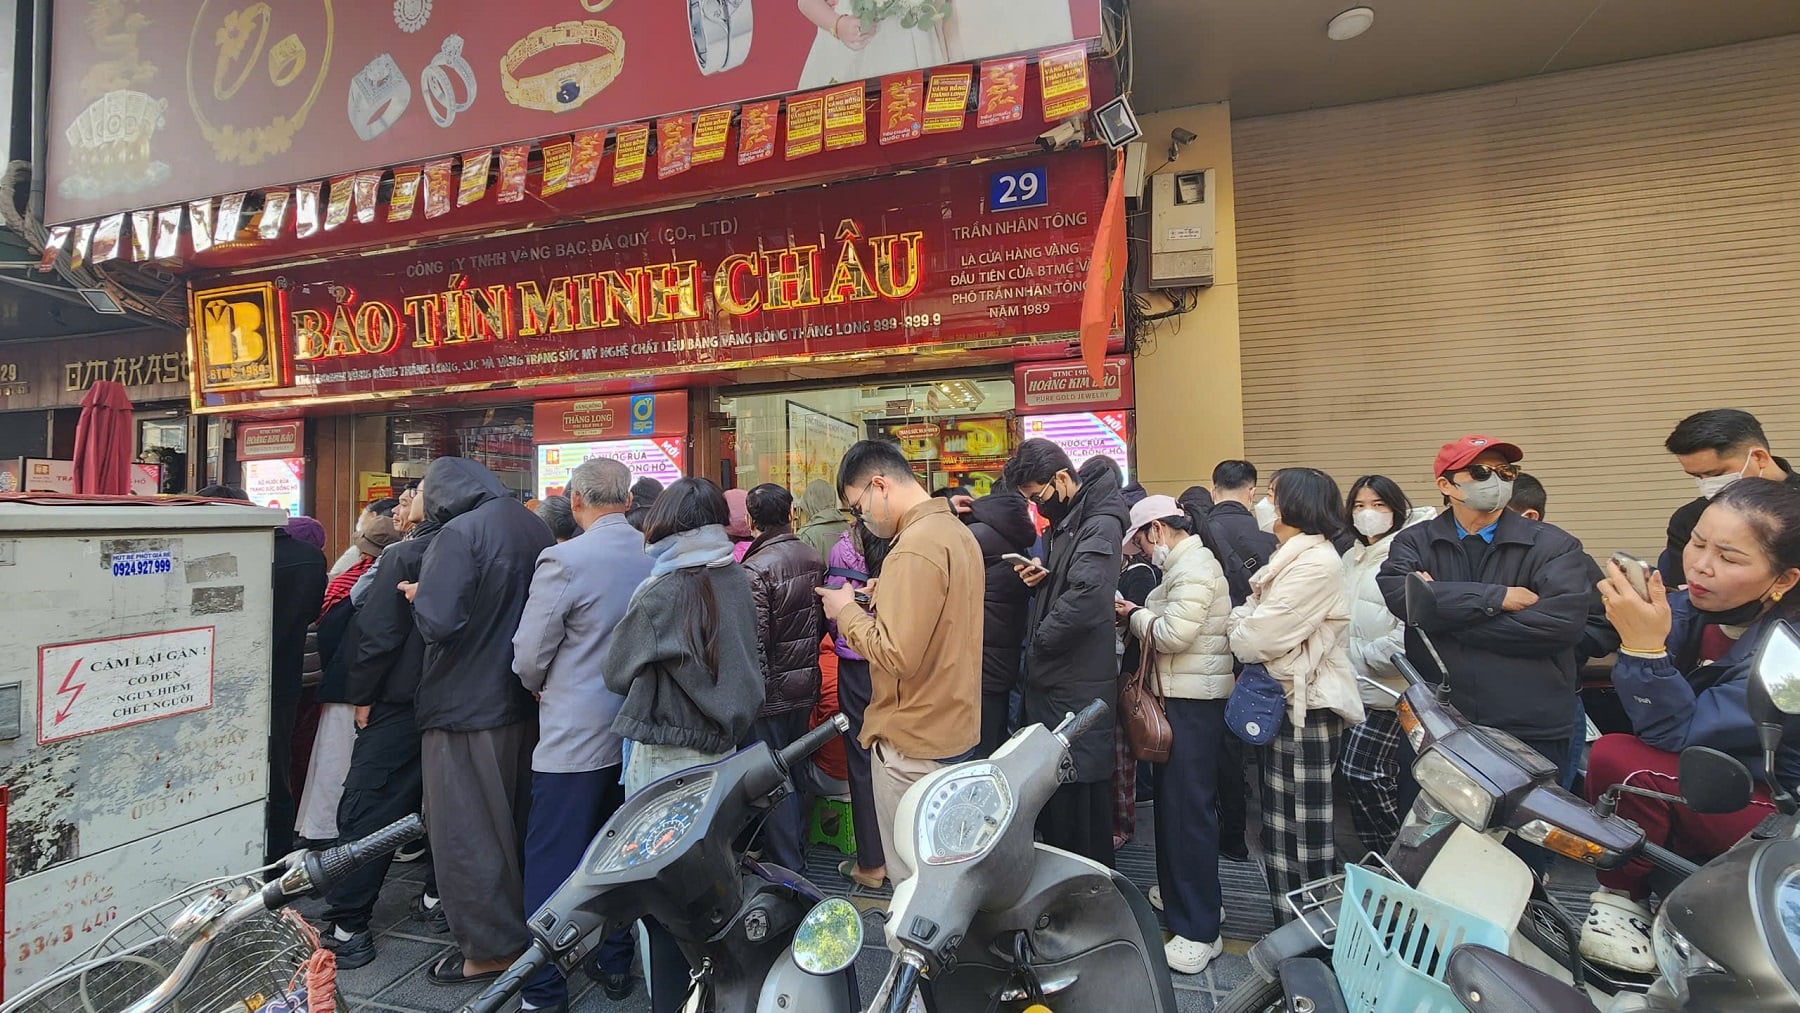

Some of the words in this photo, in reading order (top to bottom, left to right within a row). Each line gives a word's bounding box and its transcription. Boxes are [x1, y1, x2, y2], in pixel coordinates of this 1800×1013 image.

[999, 172, 1039, 204] 29
[952, 220, 992, 240] TRẦN
[996, 217, 1039, 235] NHÂN
[1042, 212, 1088, 230] TÔNG
[406, 261, 444, 278] CÔNG
[470, 252, 507, 268] TNHH
[511, 246, 551, 263] VÀNG
[592, 234, 613, 252] ĐÁ
[618, 228, 650, 249] QUÝ
[702, 216, 738, 238] LTD)
[962, 253, 976, 267] LÀ
[978, 248, 1002, 265] CỬA
[1006, 246, 1043, 261] HÀNG
[1044, 242, 1080, 256] VÀNG
[950, 270, 975, 286] ĐẦU
[979, 268, 1006, 283] TIÊN
[1008, 264, 1034, 281] CỦA
[1038, 262, 1075, 277] BTMC
[292, 285, 395, 359] BẢO
[404, 274, 505, 348] TÍN
[516, 260, 700, 336] MINH
[713, 218, 923, 315] CHÂU
[952, 290, 977, 304] PHỐ
[979, 284, 1013, 301] TRẦN
[1016, 282, 1052, 298] NHÂN
[989, 302, 1019, 319] NĂM
[1022, 303, 1050, 316] 1989
[526, 350, 558, 365] TRANG
[559, 346, 580, 362] SỨC
[631, 339, 659, 355] CHẤT
[662, 337, 685, 354] LIỆU
[688, 333, 719, 350] BẰNG
[719, 330, 753, 347] VÀNG
[754, 326, 788, 344] RỒNG
[792, 322, 834, 340] THĂNG
[836, 320, 871, 336] LONG
[242, 364, 265, 376] 1989
[1053, 370, 1074, 378] BTMC
[1028, 377, 1067, 392] HOÀNG
[1068, 377, 1090, 389] KIM
[1077, 392, 1109, 400] JEWELRY
[564, 415, 590, 425] THĂNG
[592, 414, 612, 422] LONG
[1102, 414, 1123, 432] MỚI
[627, 450, 647, 461] RỬA
[660, 440, 680, 458] MỚI
[629, 462, 649, 473] ỒNG
[651, 460, 666, 472] HỒ
[114, 559, 171, 577] 0924.927.999
[90, 657, 130, 672] CẤM
[136, 652, 162, 668] LẠI
[166, 647, 199, 661] GẦN
[128, 674, 148, 686] CÓ
[152, 670, 182, 683] ĐIỆN
[117, 690, 156, 703] NGUY
[158, 683, 191, 696] HIỂM
[112, 703, 150, 719] CHẾT
[154, 694, 194, 709] NGƯỜI
